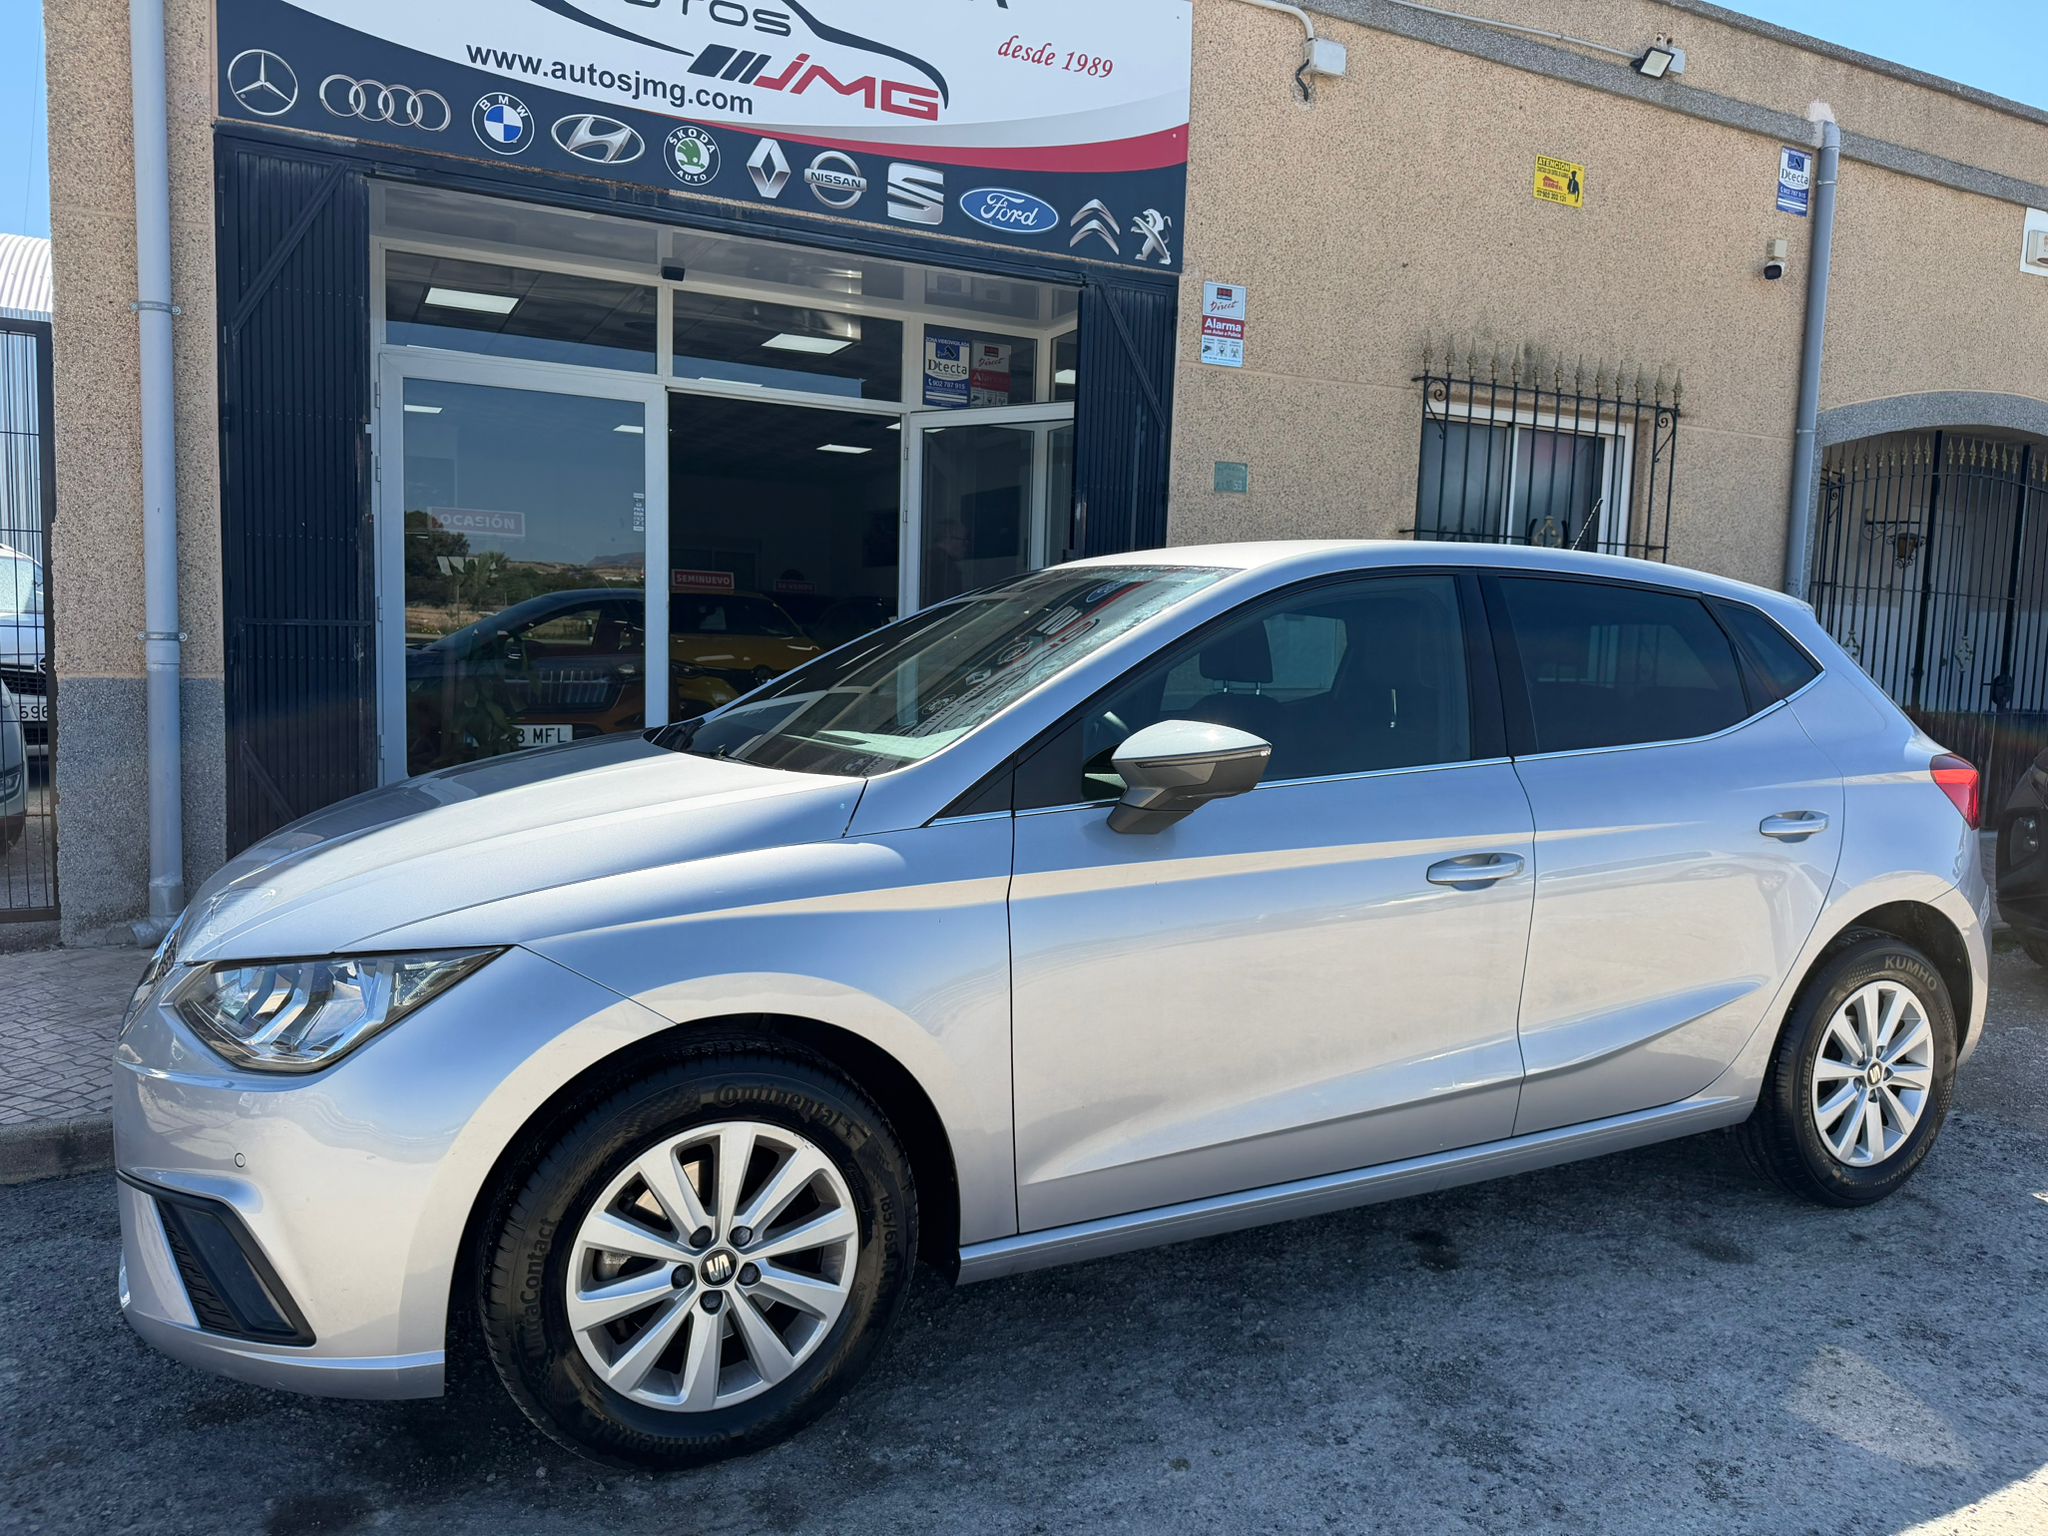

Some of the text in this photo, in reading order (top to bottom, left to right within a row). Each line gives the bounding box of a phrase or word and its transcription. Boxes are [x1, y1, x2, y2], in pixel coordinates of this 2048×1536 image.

[998, 35, 1114, 79] desde 1989
[466, 44, 754, 115] www.autosjmg.com
[479, 95, 529, 118] BMW
[677, 169, 708, 183] AUTO
[810, 170, 862, 188] NISSAN
[1781, 169, 1808, 184] Dtecta
[980, 192, 1038, 227] Ford
[1205, 319, 1242, 331] Alarma
[927, 359, 968, 375] Dtecta
[440, 513, 516, 531] OCASIÓN
[676, 573, 731, 585] SEMINUEVO
[533, 727, 567, 744] MFL
[1884, 955, 1938, 991] KUMHO
